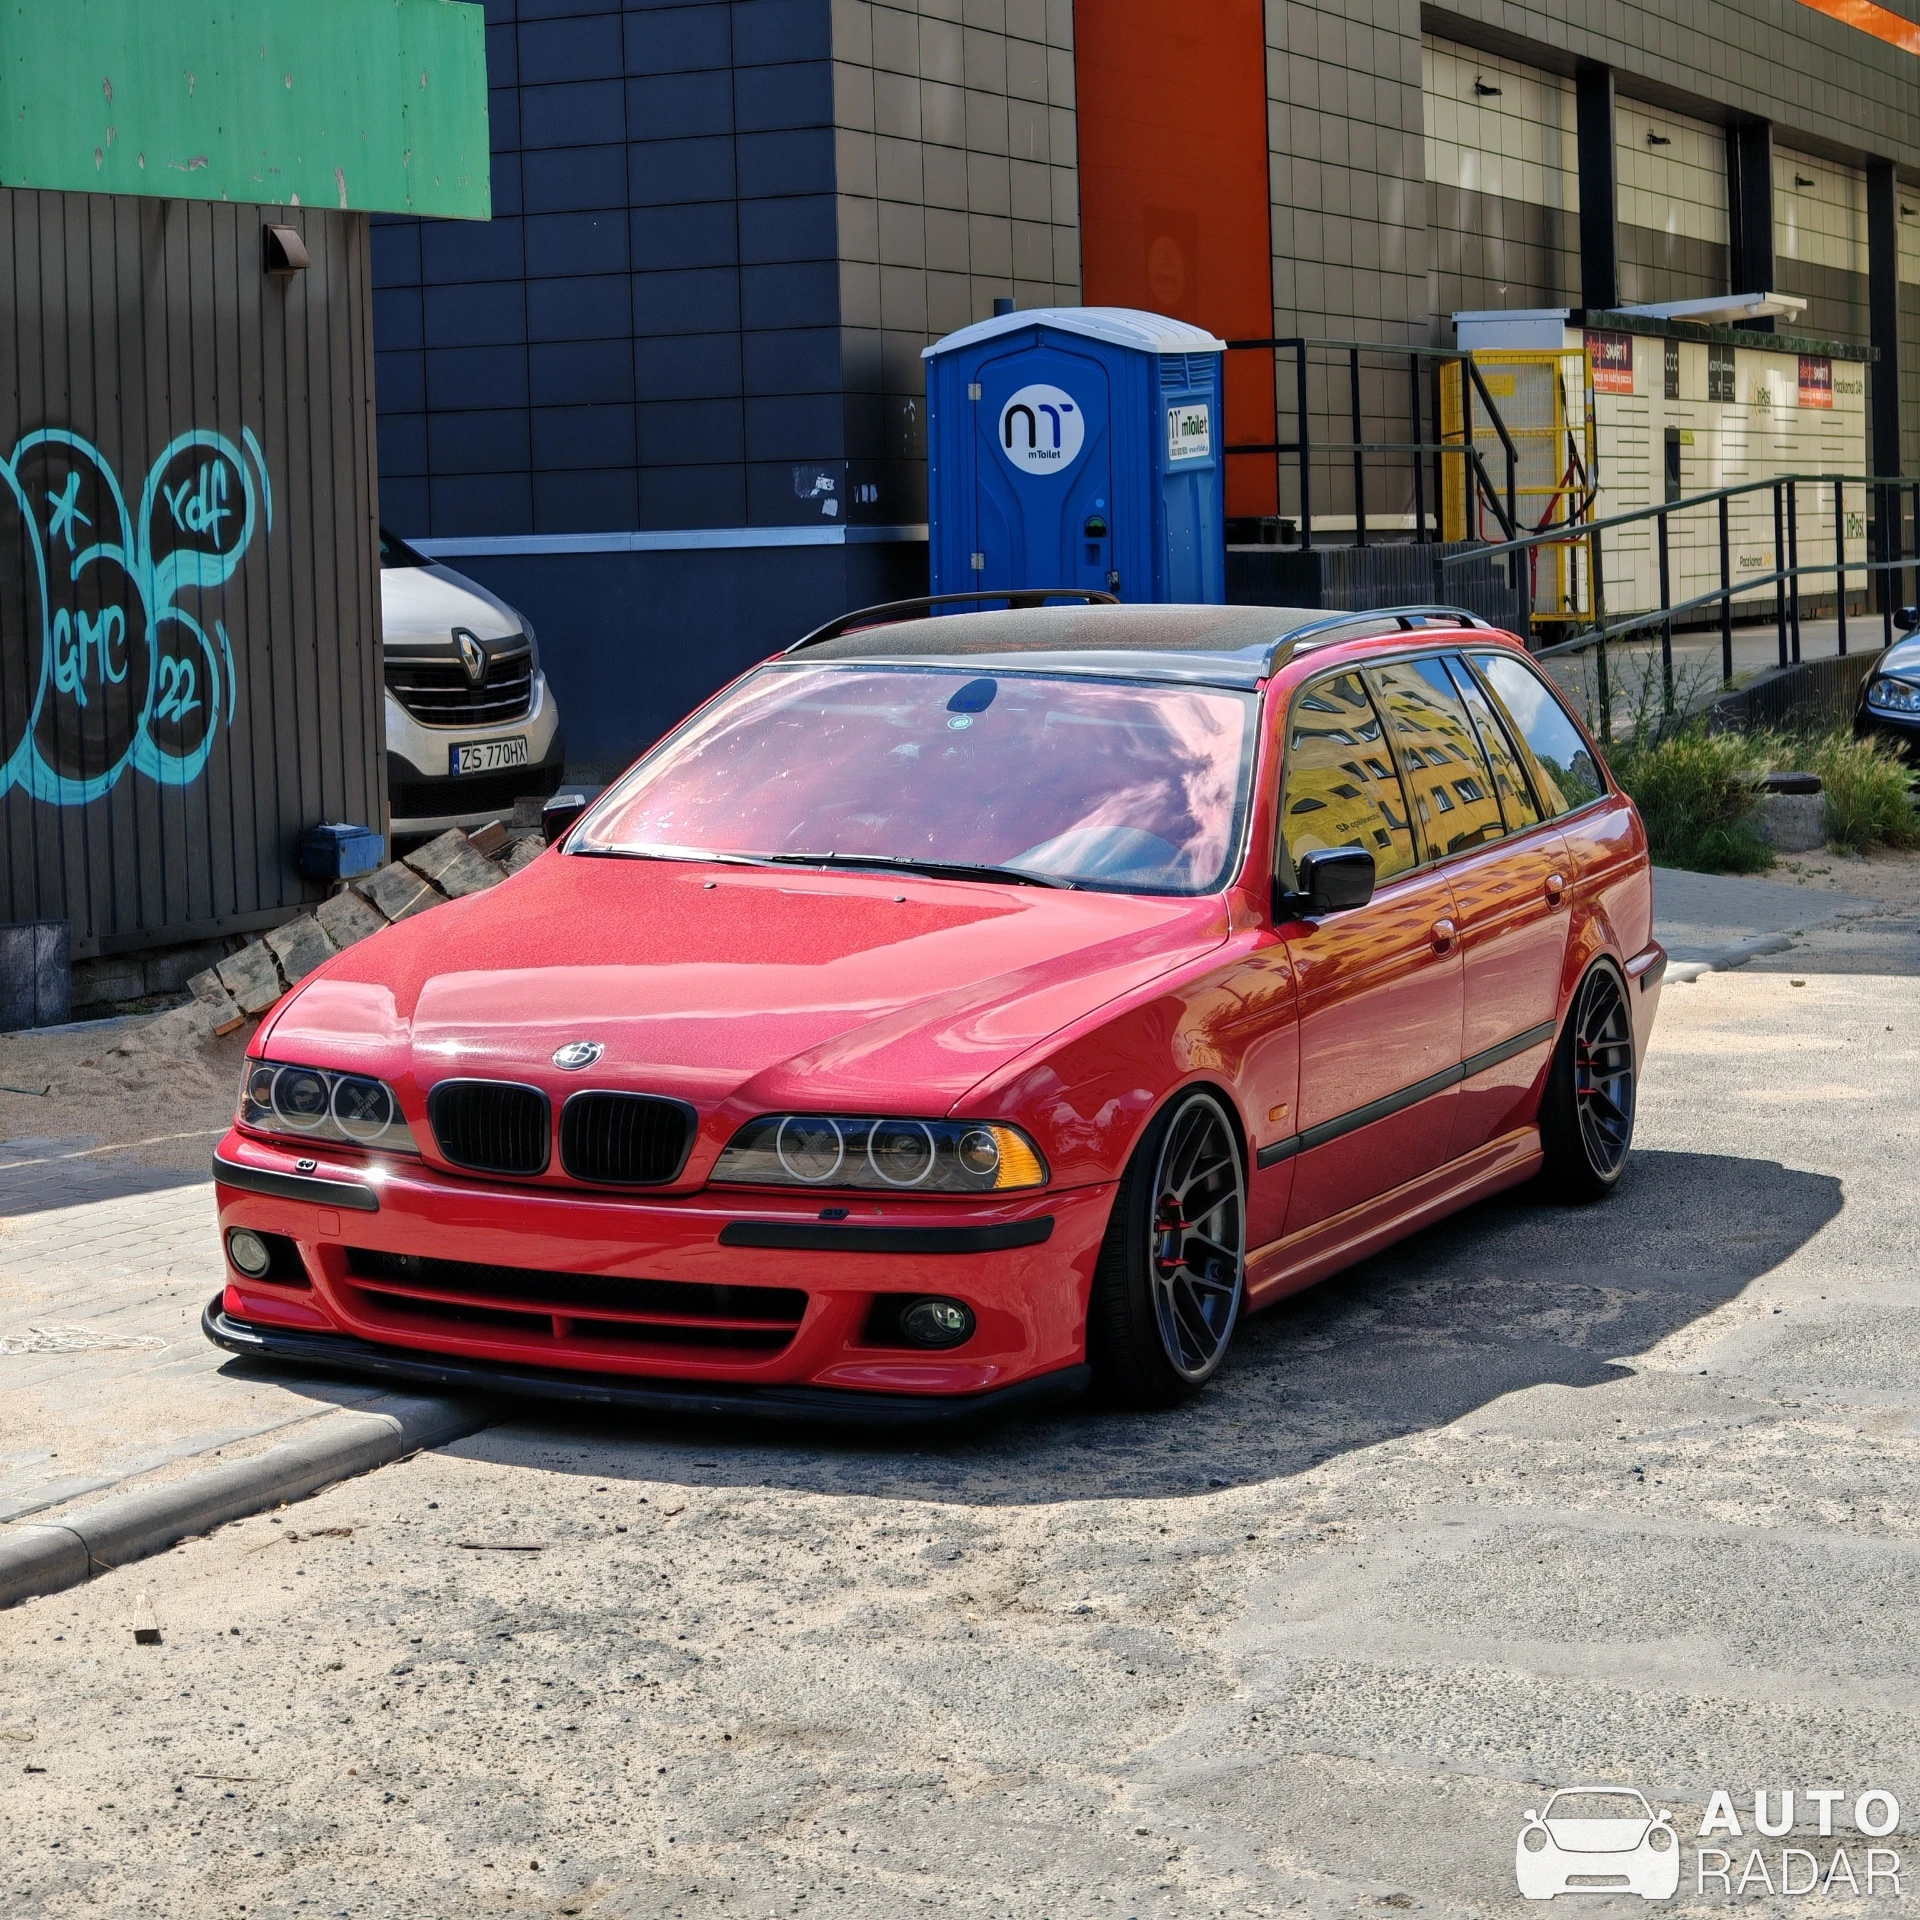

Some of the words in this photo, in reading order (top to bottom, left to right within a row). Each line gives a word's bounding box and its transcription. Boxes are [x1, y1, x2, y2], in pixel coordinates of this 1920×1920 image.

[1665, 352, 1678, 372] CCC
[1182, 414, 1208, 437] mToilet
[1028, 449, 1061, 459] mToilet
[461, 748, 482, 771] ZS
[486, 740, 526, 767] 770HX
